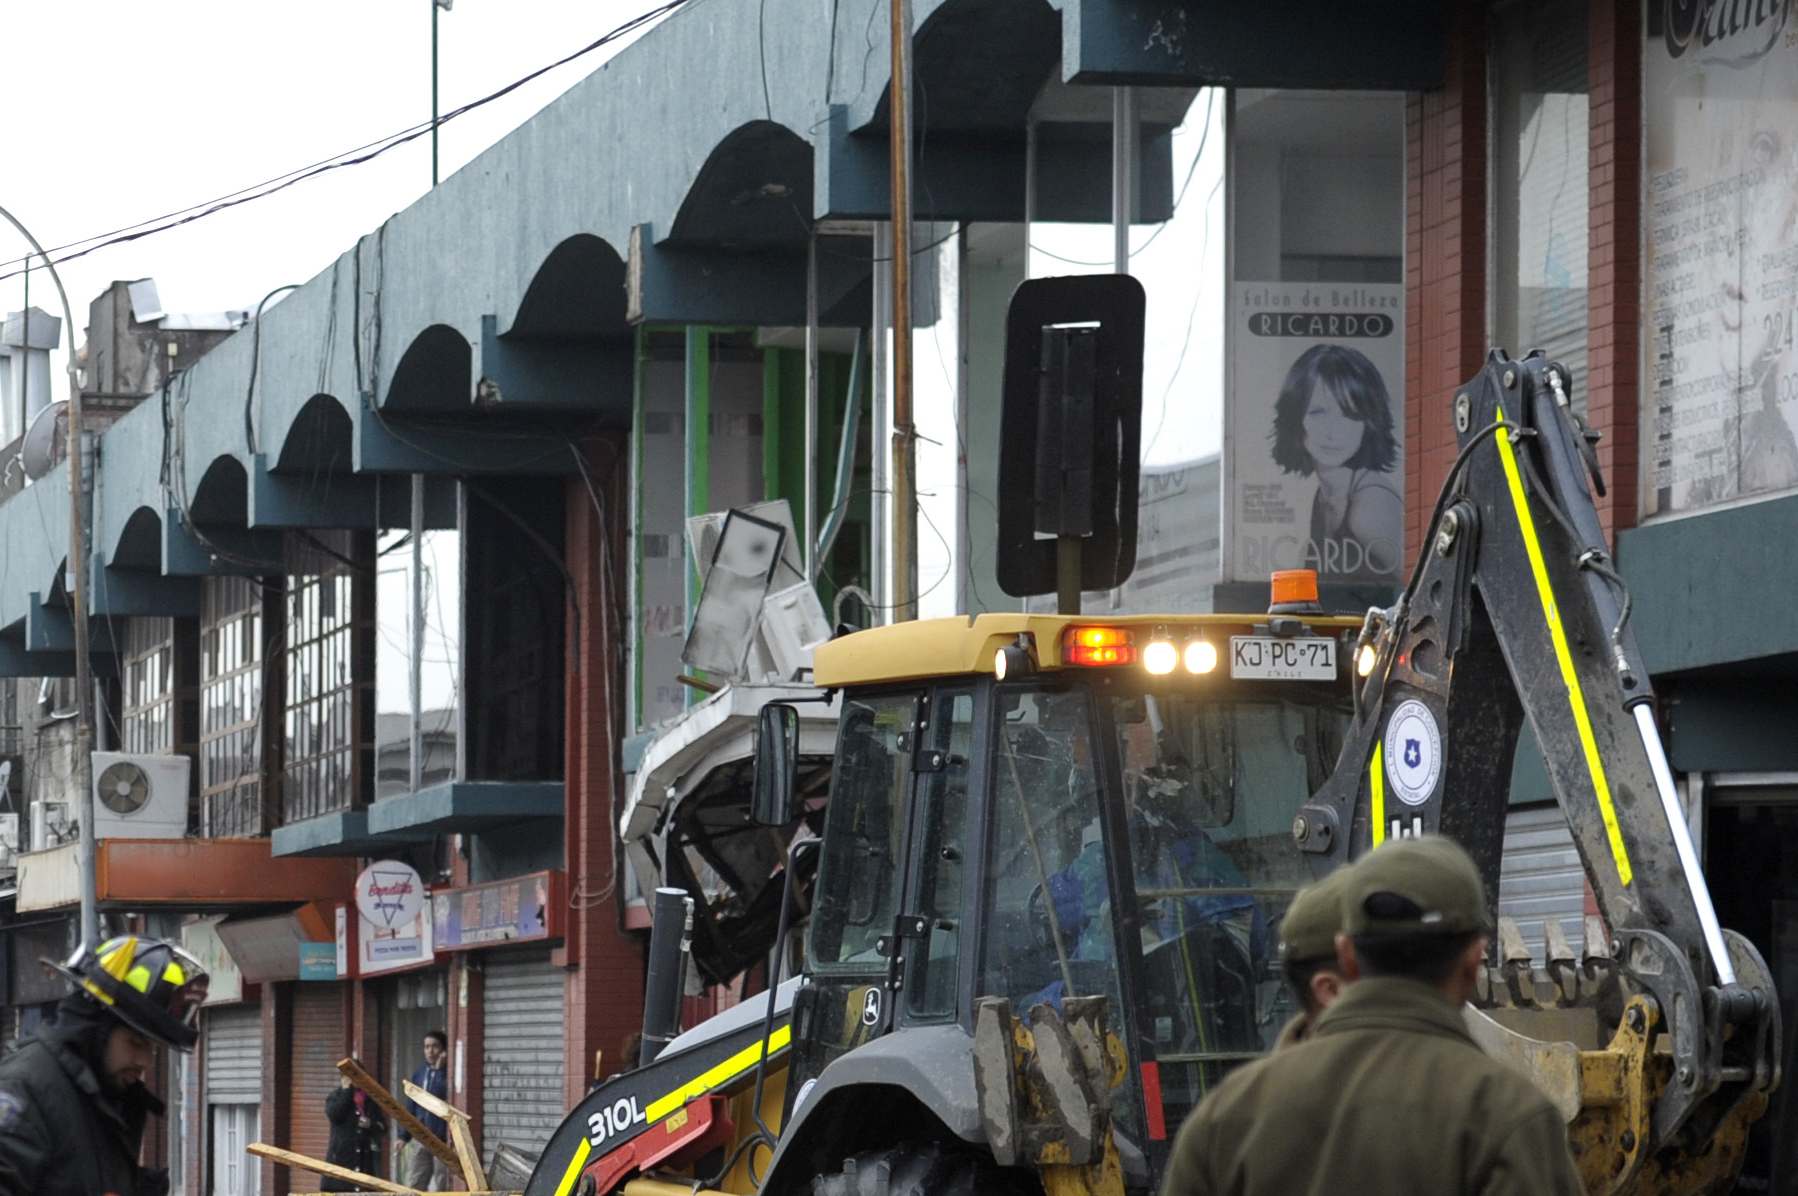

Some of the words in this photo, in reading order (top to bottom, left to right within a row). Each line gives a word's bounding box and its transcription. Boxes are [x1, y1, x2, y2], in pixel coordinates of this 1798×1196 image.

[1260, 315, 1385, 336] RICARDO
[1241, 535, 1400, 575] RICARDO
[588, 1095, 646, 1147] 310L
